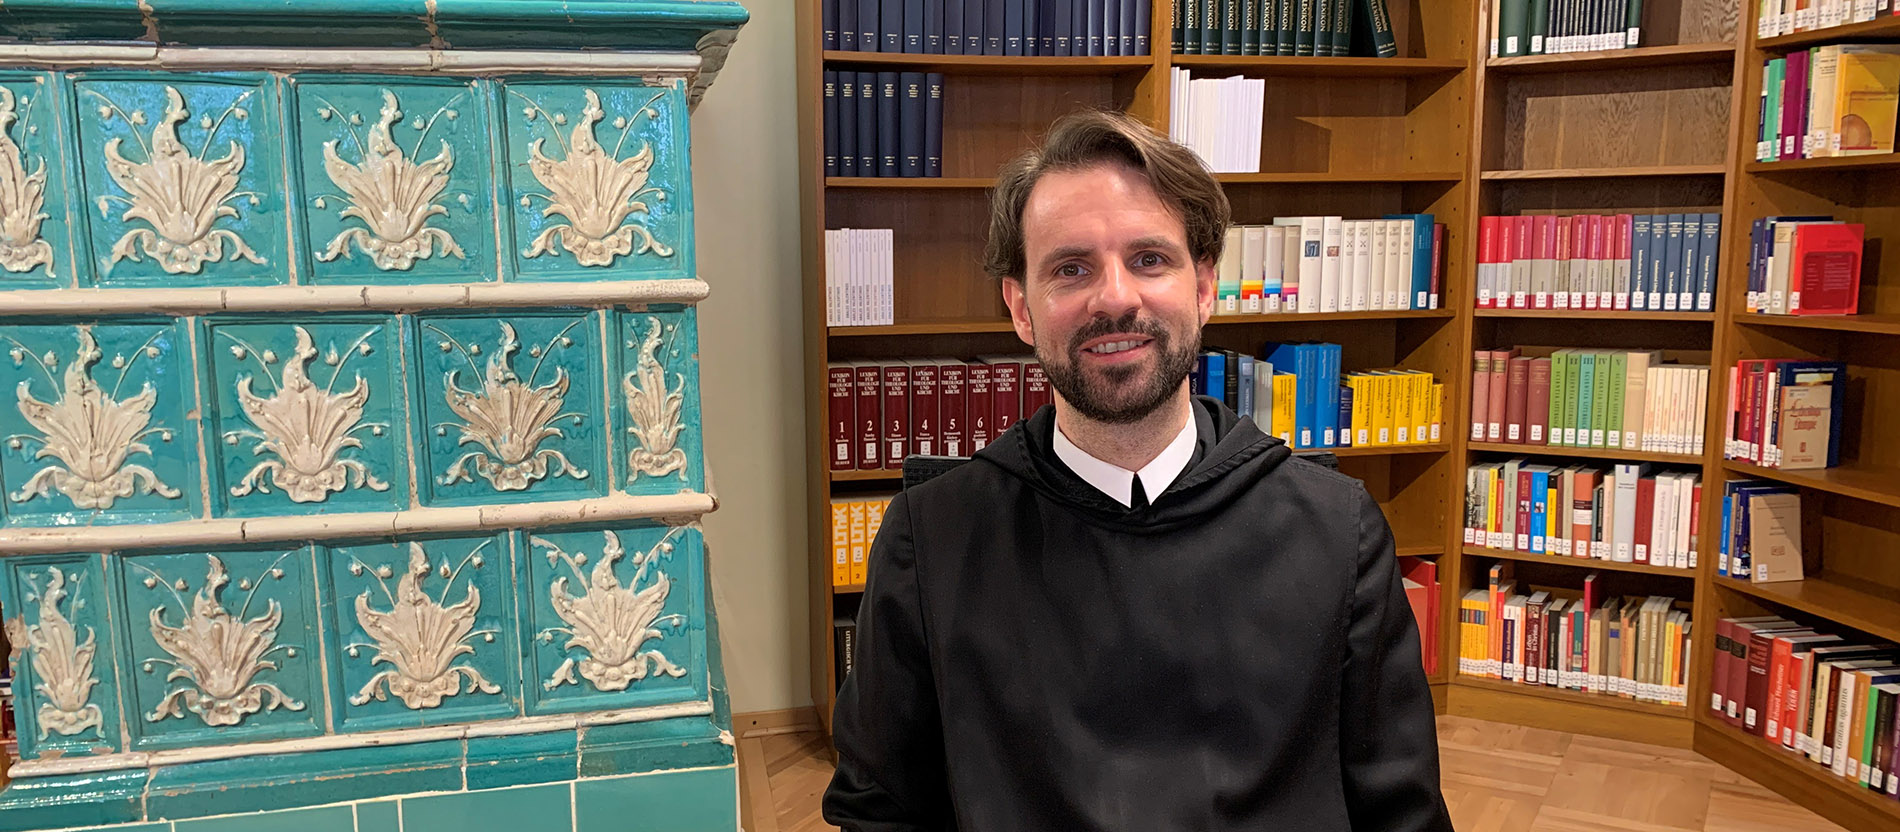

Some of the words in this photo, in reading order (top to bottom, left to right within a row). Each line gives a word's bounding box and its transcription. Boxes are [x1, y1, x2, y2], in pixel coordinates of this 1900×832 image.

[867, 420, 873, 431] 2
[893, 420, 899, 431] 3
[922, 419, 928, 430] 4
[950, 419, 956, 429] 5
[977, 417, 983, 428] 6
[1002, 416, 1008, 426] 7
[840, 422, 844, 432] 1
[833, 506, 847, 545] LThK
[850, 504, 864, 543] LThK
[1839, 688, 1848, 720] agamus
[1836, 721, 1844, 749] Gratias
